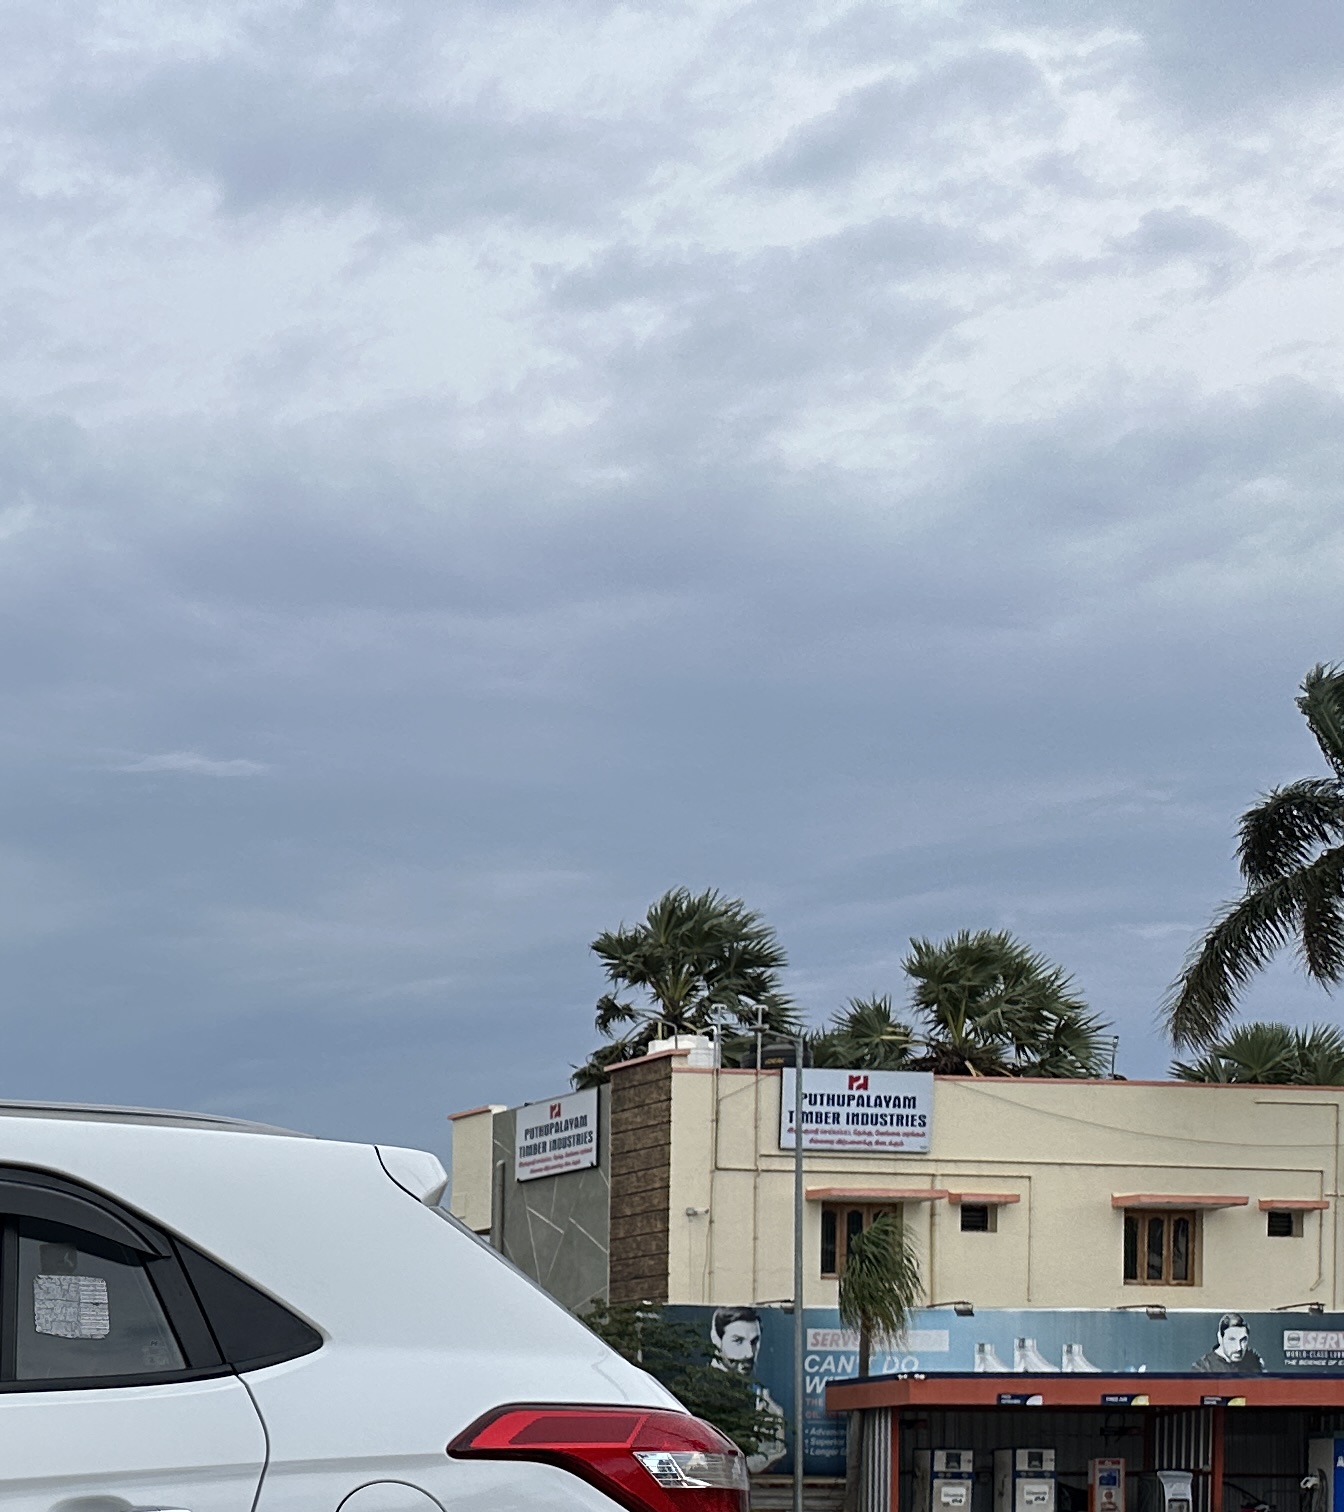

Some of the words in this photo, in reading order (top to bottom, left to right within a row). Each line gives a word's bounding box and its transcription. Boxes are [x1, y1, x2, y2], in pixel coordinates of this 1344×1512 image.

[524, 1114, 588, 1141] PUTHUPALAYAM
[788, 1110, 841, 1125] TMBER
[846, 1112, 928, 1129] INDUSTRIES
[519, 1141, 548, 1159] TIMBER
[548, 1130, 594, 1152] INDUSTRIES
